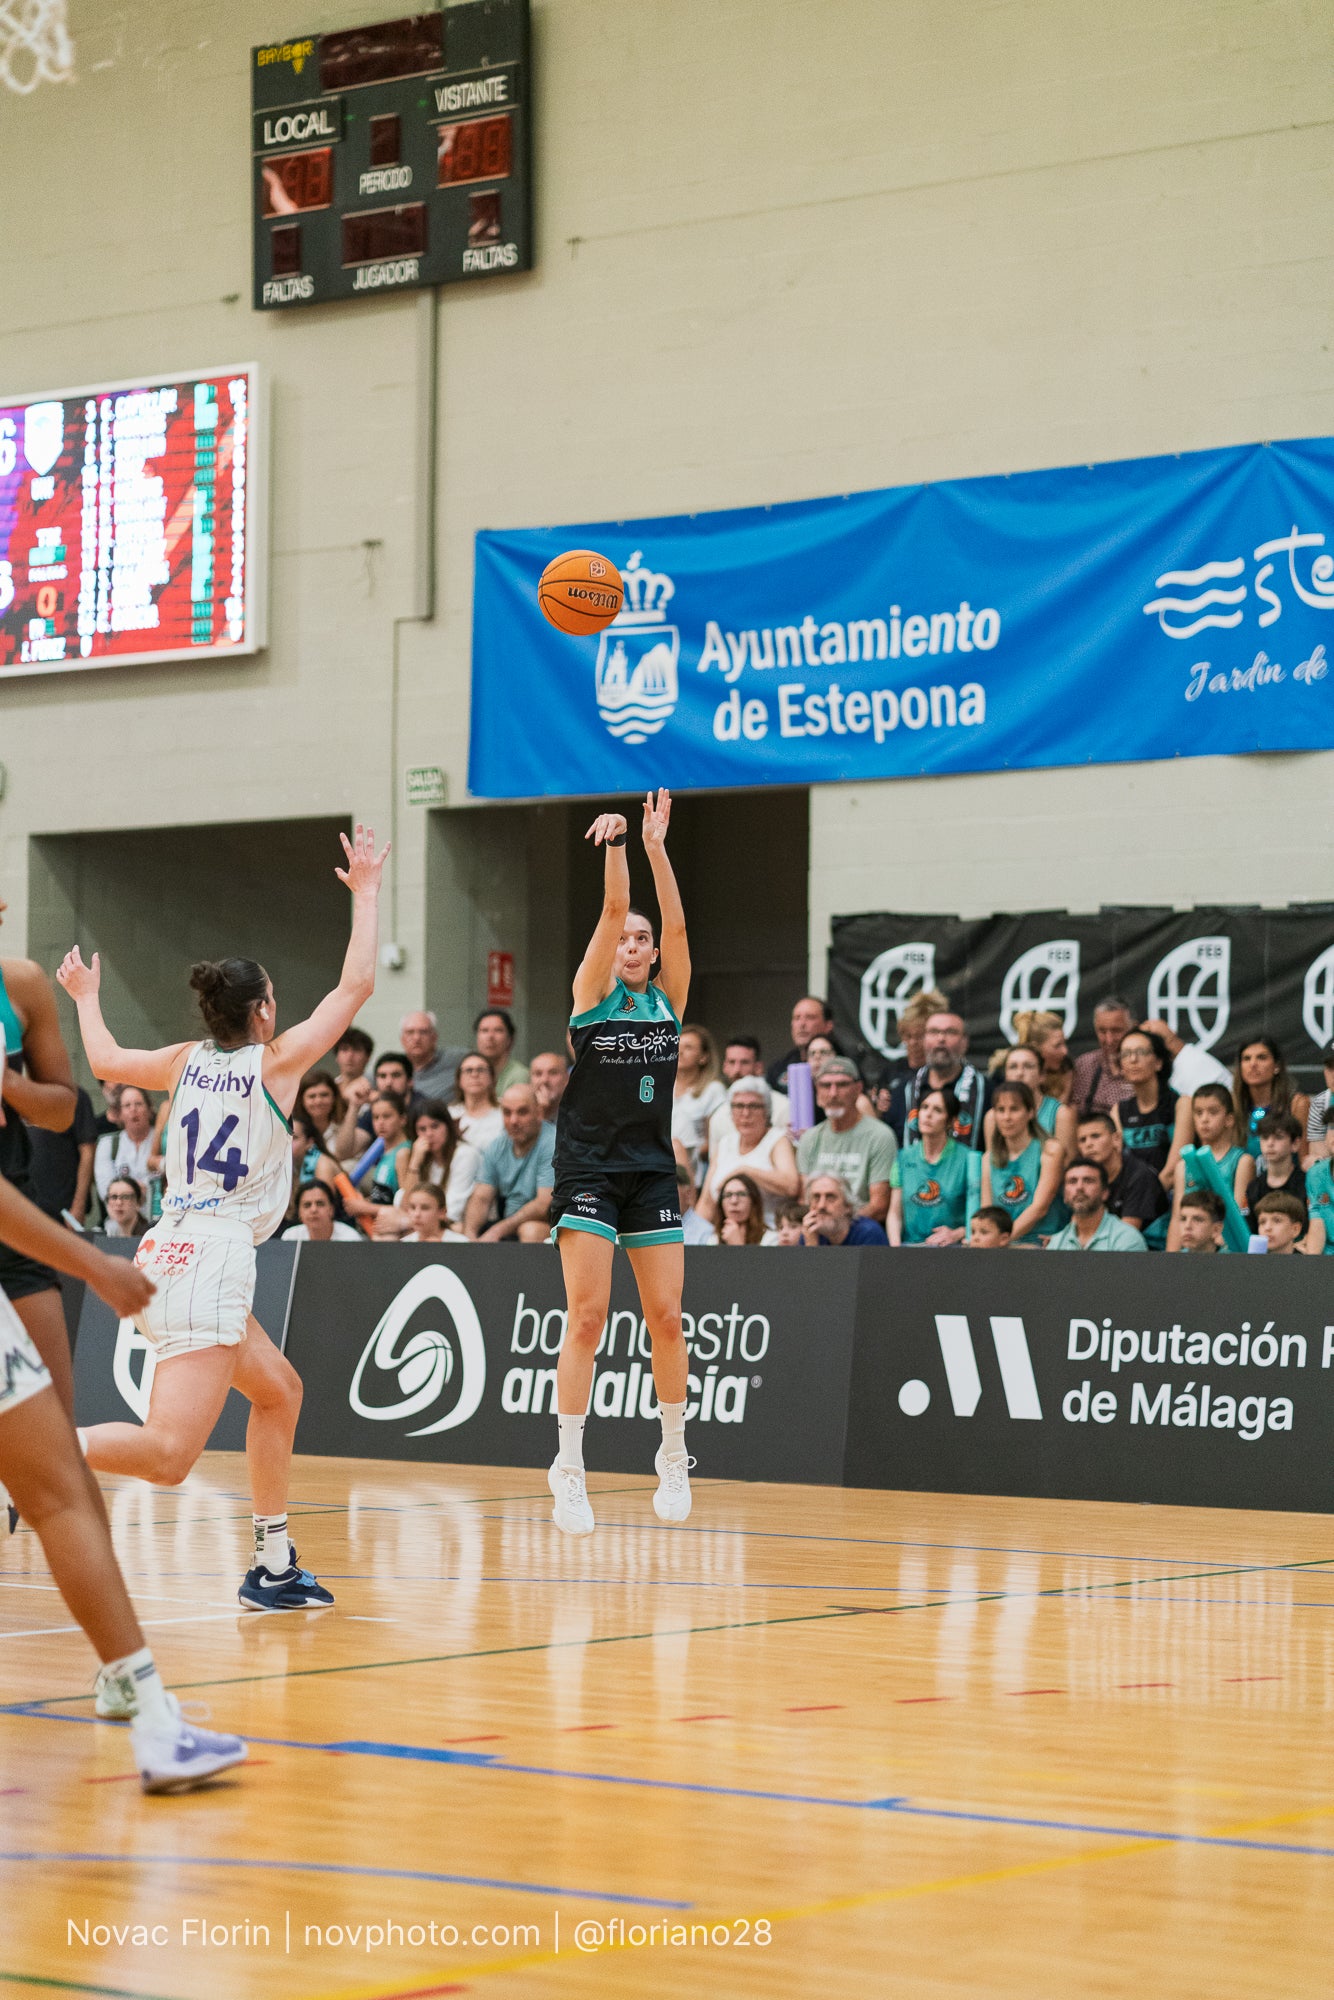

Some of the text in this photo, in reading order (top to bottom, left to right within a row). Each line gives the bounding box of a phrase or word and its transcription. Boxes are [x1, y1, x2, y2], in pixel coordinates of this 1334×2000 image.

[435, 75, 509, 112] VISITANTE
[264, 110, 336, 144] LOCAL
[359, 165, 413, 195] PERIODO
[353, 259, 420, 290] JUGADOR
[462, 243, 518, 272] FALTAS
[263, 275, 315, 304] FALTAS
[567, 587, 619, 609] Wilson
[696, 601, 1001, 684] Ayuntamiento
[1292, 643, 1330, 686] de
[712, 682, 987, 744] de Estepona
[639, 1075, 655, 1103] 6
[180, 1107, 250, 1193] 14
[577, 1204, 598, 1215] vive
[1067, 1317, 1308, 1373] Diputación
[1062, 1380, 1294, 1441] de Málaga
